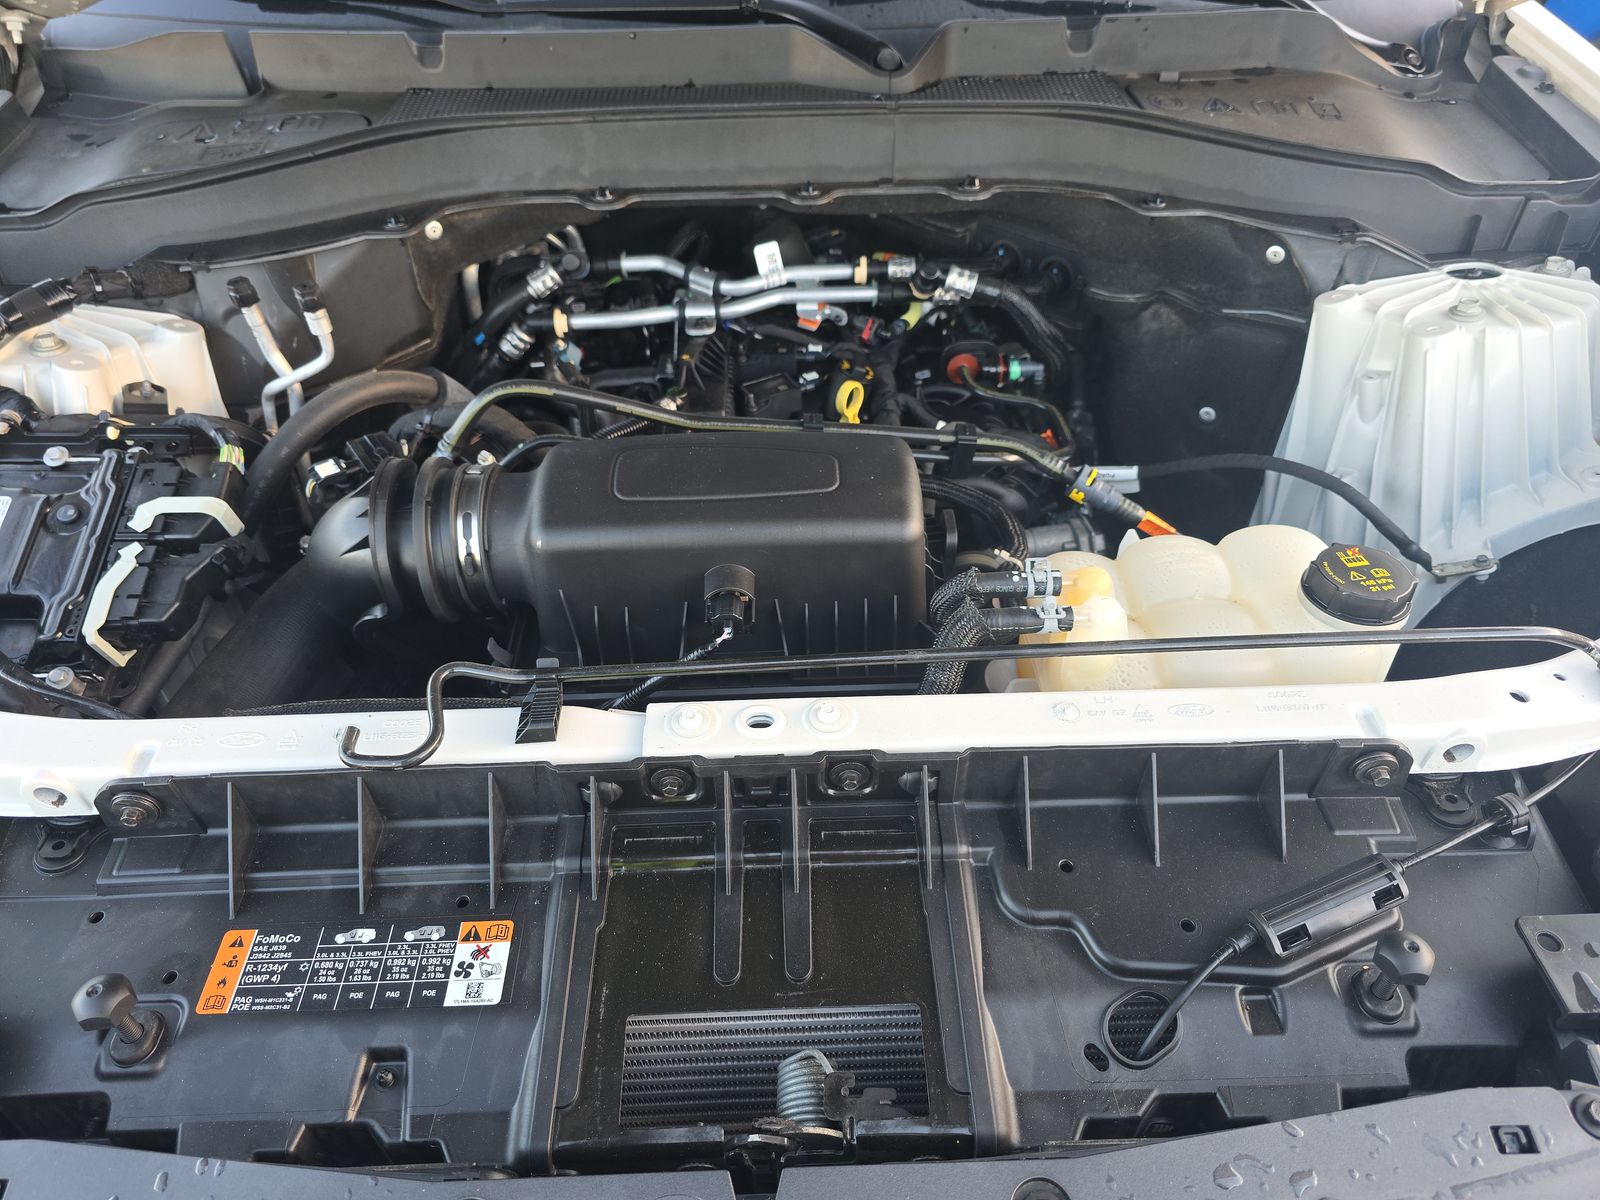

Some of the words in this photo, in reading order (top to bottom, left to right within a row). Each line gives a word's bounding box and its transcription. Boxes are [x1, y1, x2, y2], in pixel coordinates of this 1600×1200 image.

[255, 934, 301, 944] FoMoCo
[335, 961, 344, 969] kg
[370, 960, 379, 968] kg
[407, 958, 416, 966] kg
[442, 957, 452, 966] kg
[246, 963, 289, 973] R-1234yf
[242, 974, 269, 985] (GWP
[271, 974, 280, 984] 4)
